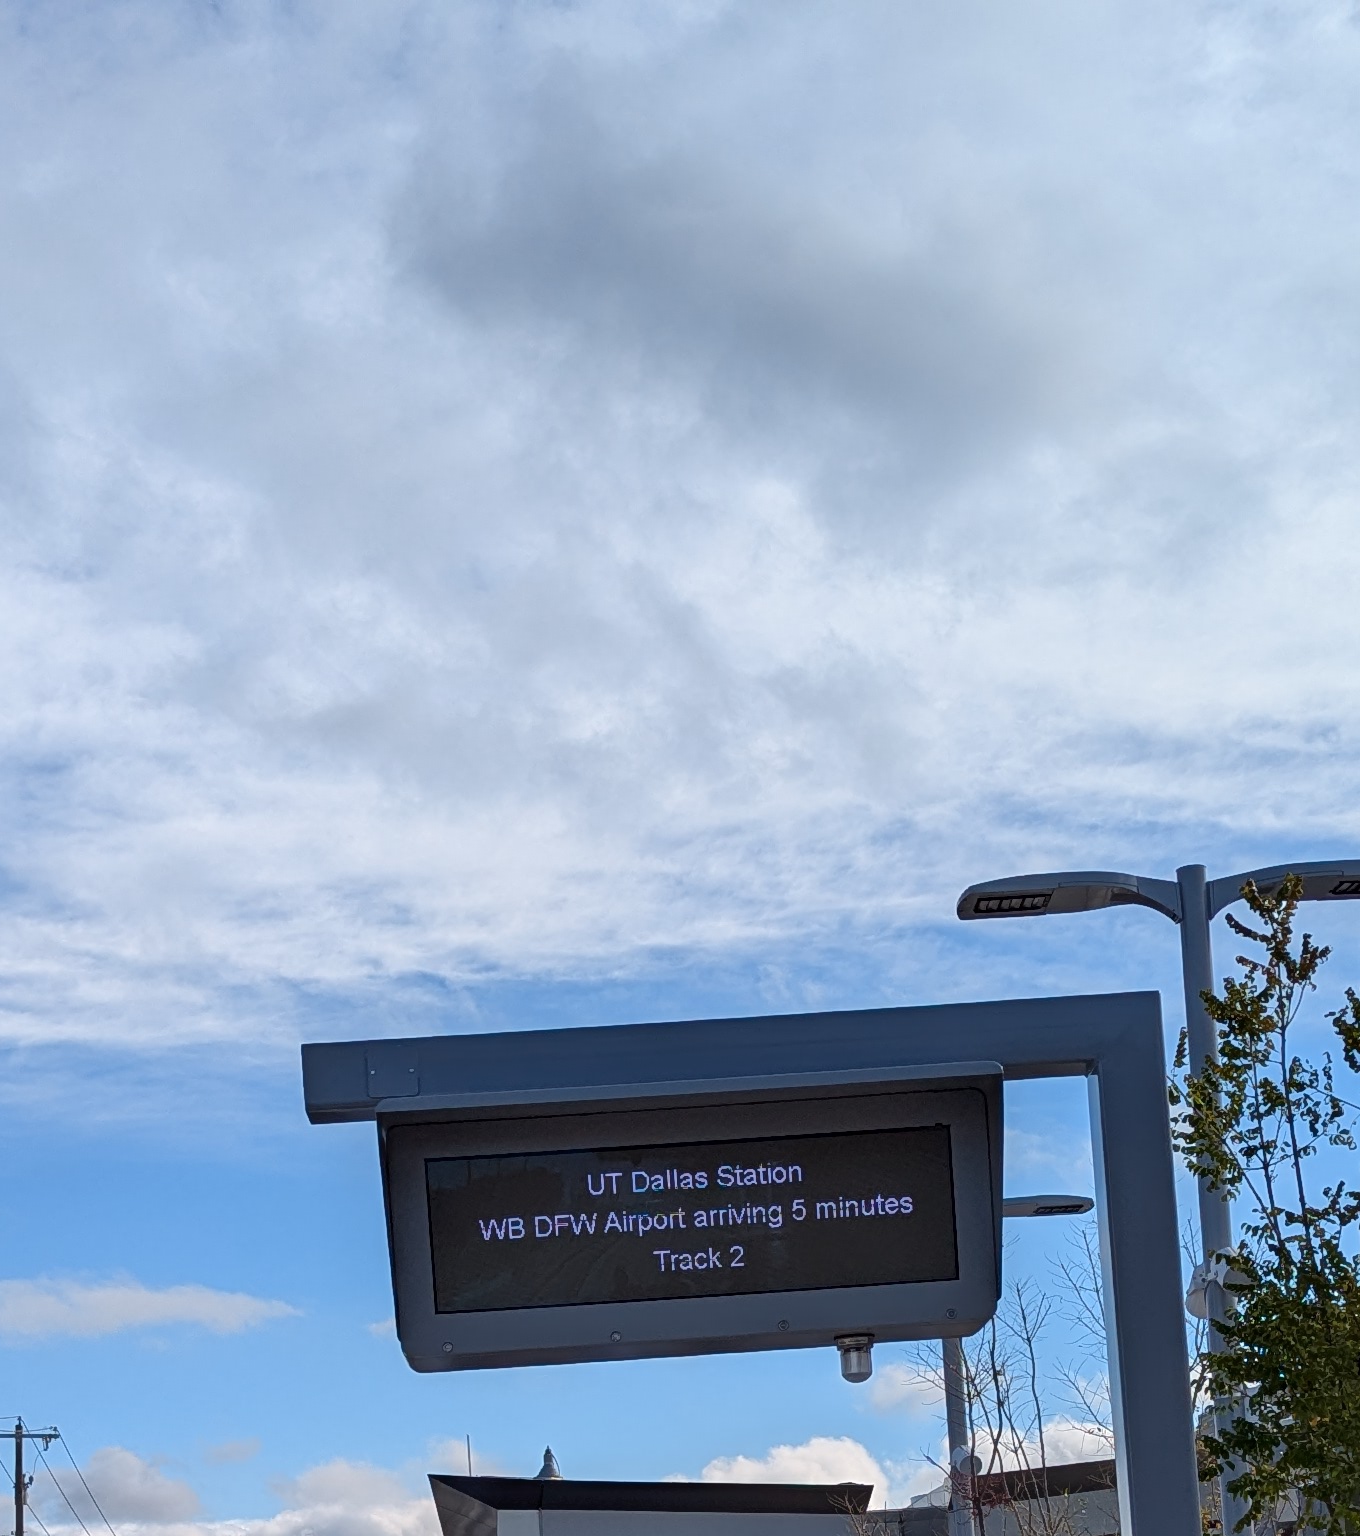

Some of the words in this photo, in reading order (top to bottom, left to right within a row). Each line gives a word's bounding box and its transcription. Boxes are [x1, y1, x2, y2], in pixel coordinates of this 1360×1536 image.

[587, 1172, 623, 1196] UT
[631, 1168, 709, 1193] Dallas
[716, 1163, 803, 1187] Station
[478, 1216, 526, 1241] WB
[534, 1212, 598, 1238] DFW
[603, 1207, 687, 1237] Airport
[693, 1203, 783, 1228] arriving
[791, 1198, 808, 1221] 5
[815, 1194, 914, 1220] minutes
[652, 1247, 723, 1272] Track
[729, 1245, 745, 1267] 2
